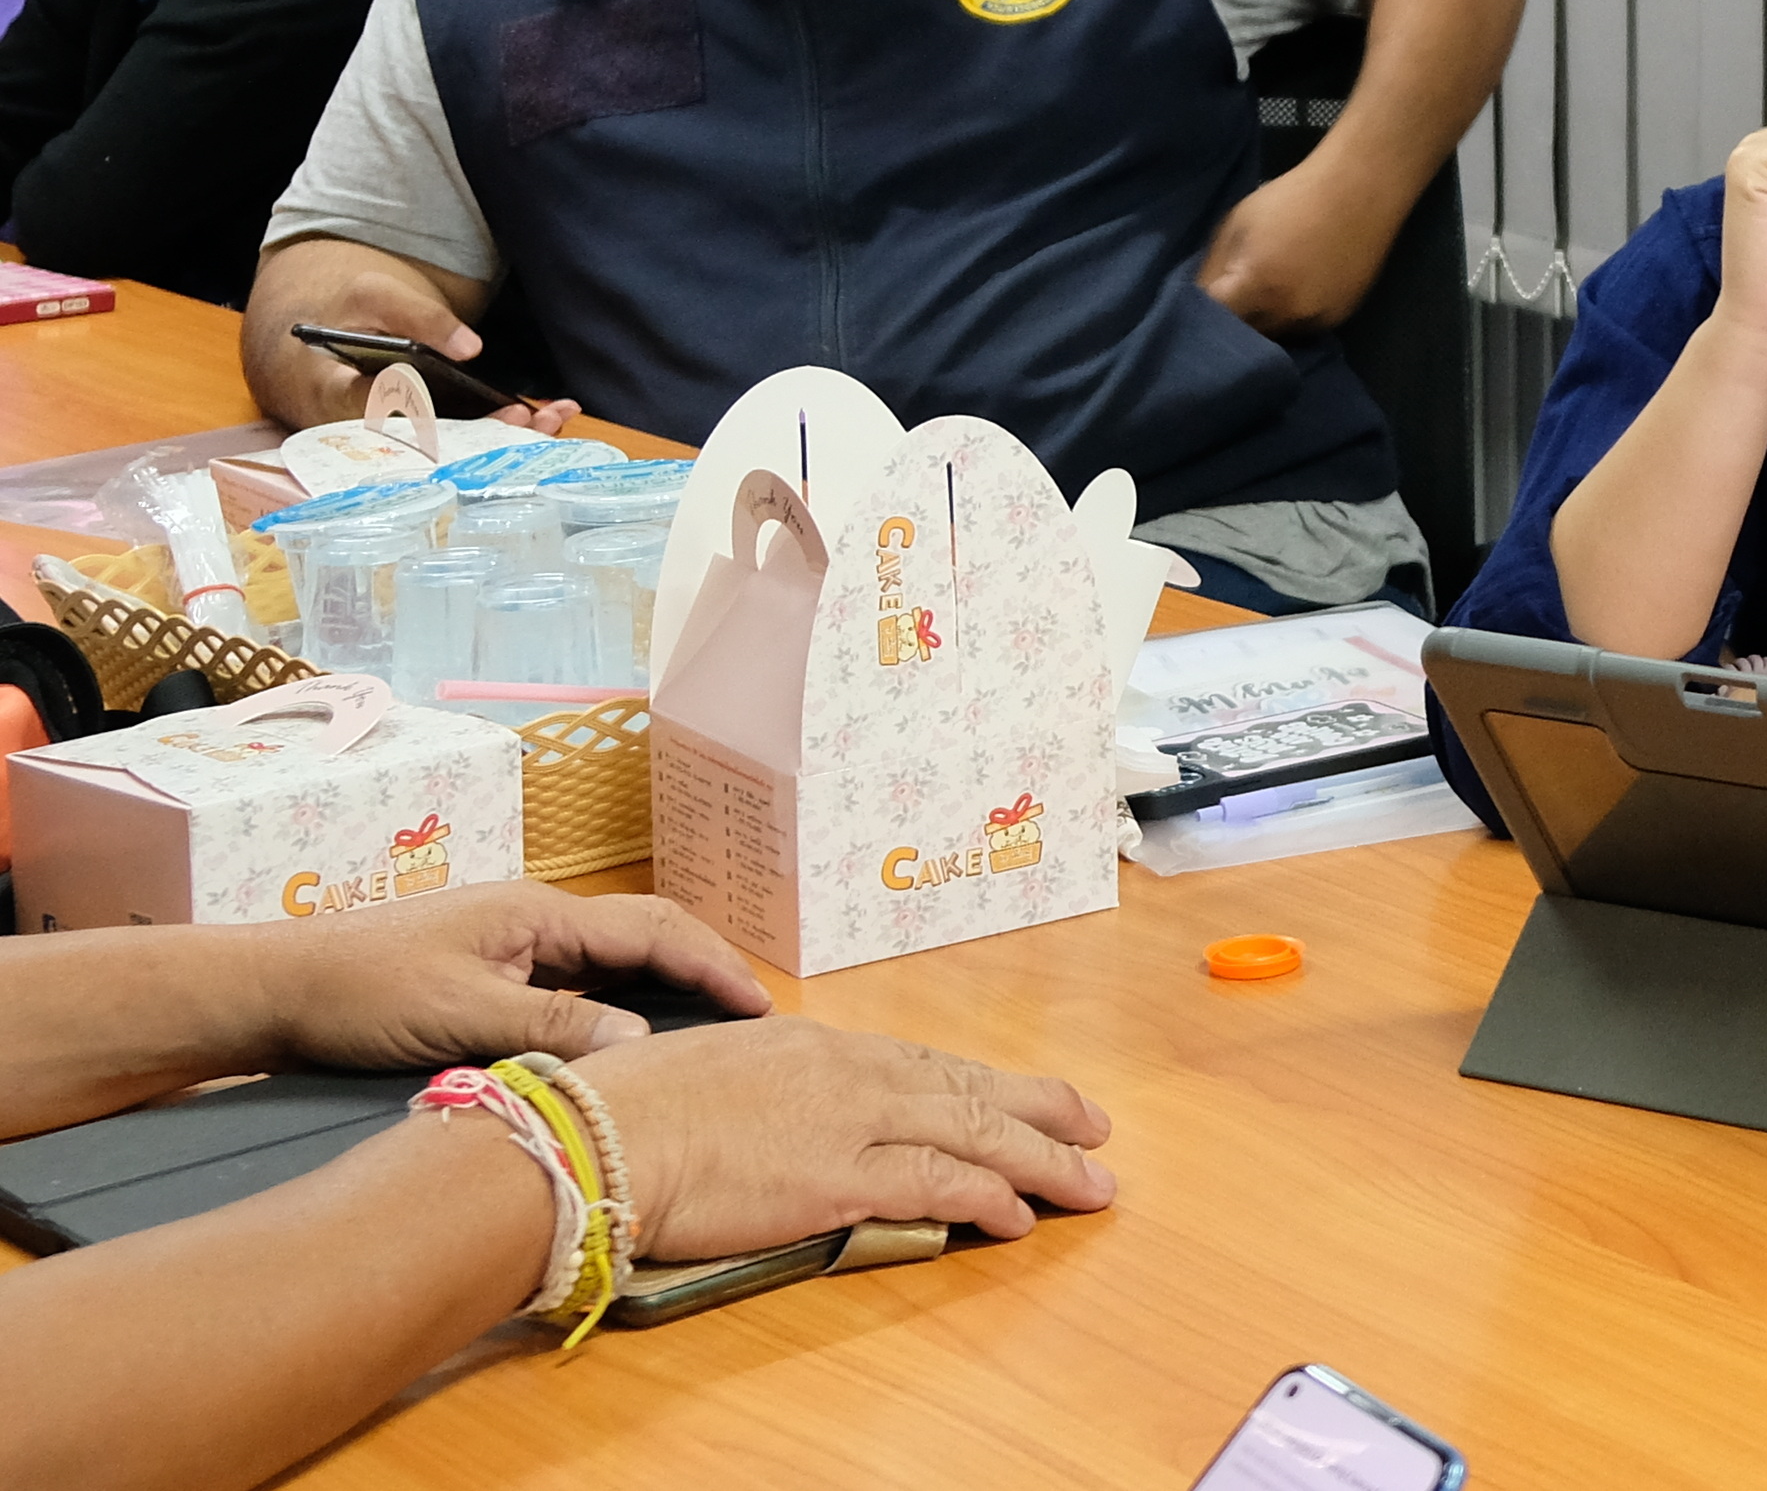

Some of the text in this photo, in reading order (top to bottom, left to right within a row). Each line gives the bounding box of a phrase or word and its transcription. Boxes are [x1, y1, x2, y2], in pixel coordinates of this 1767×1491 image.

[876, 516, 915, 611] CAKE
[881, 846, 983, 890] CAKE
[282, 871, 388, 917] CAKE
